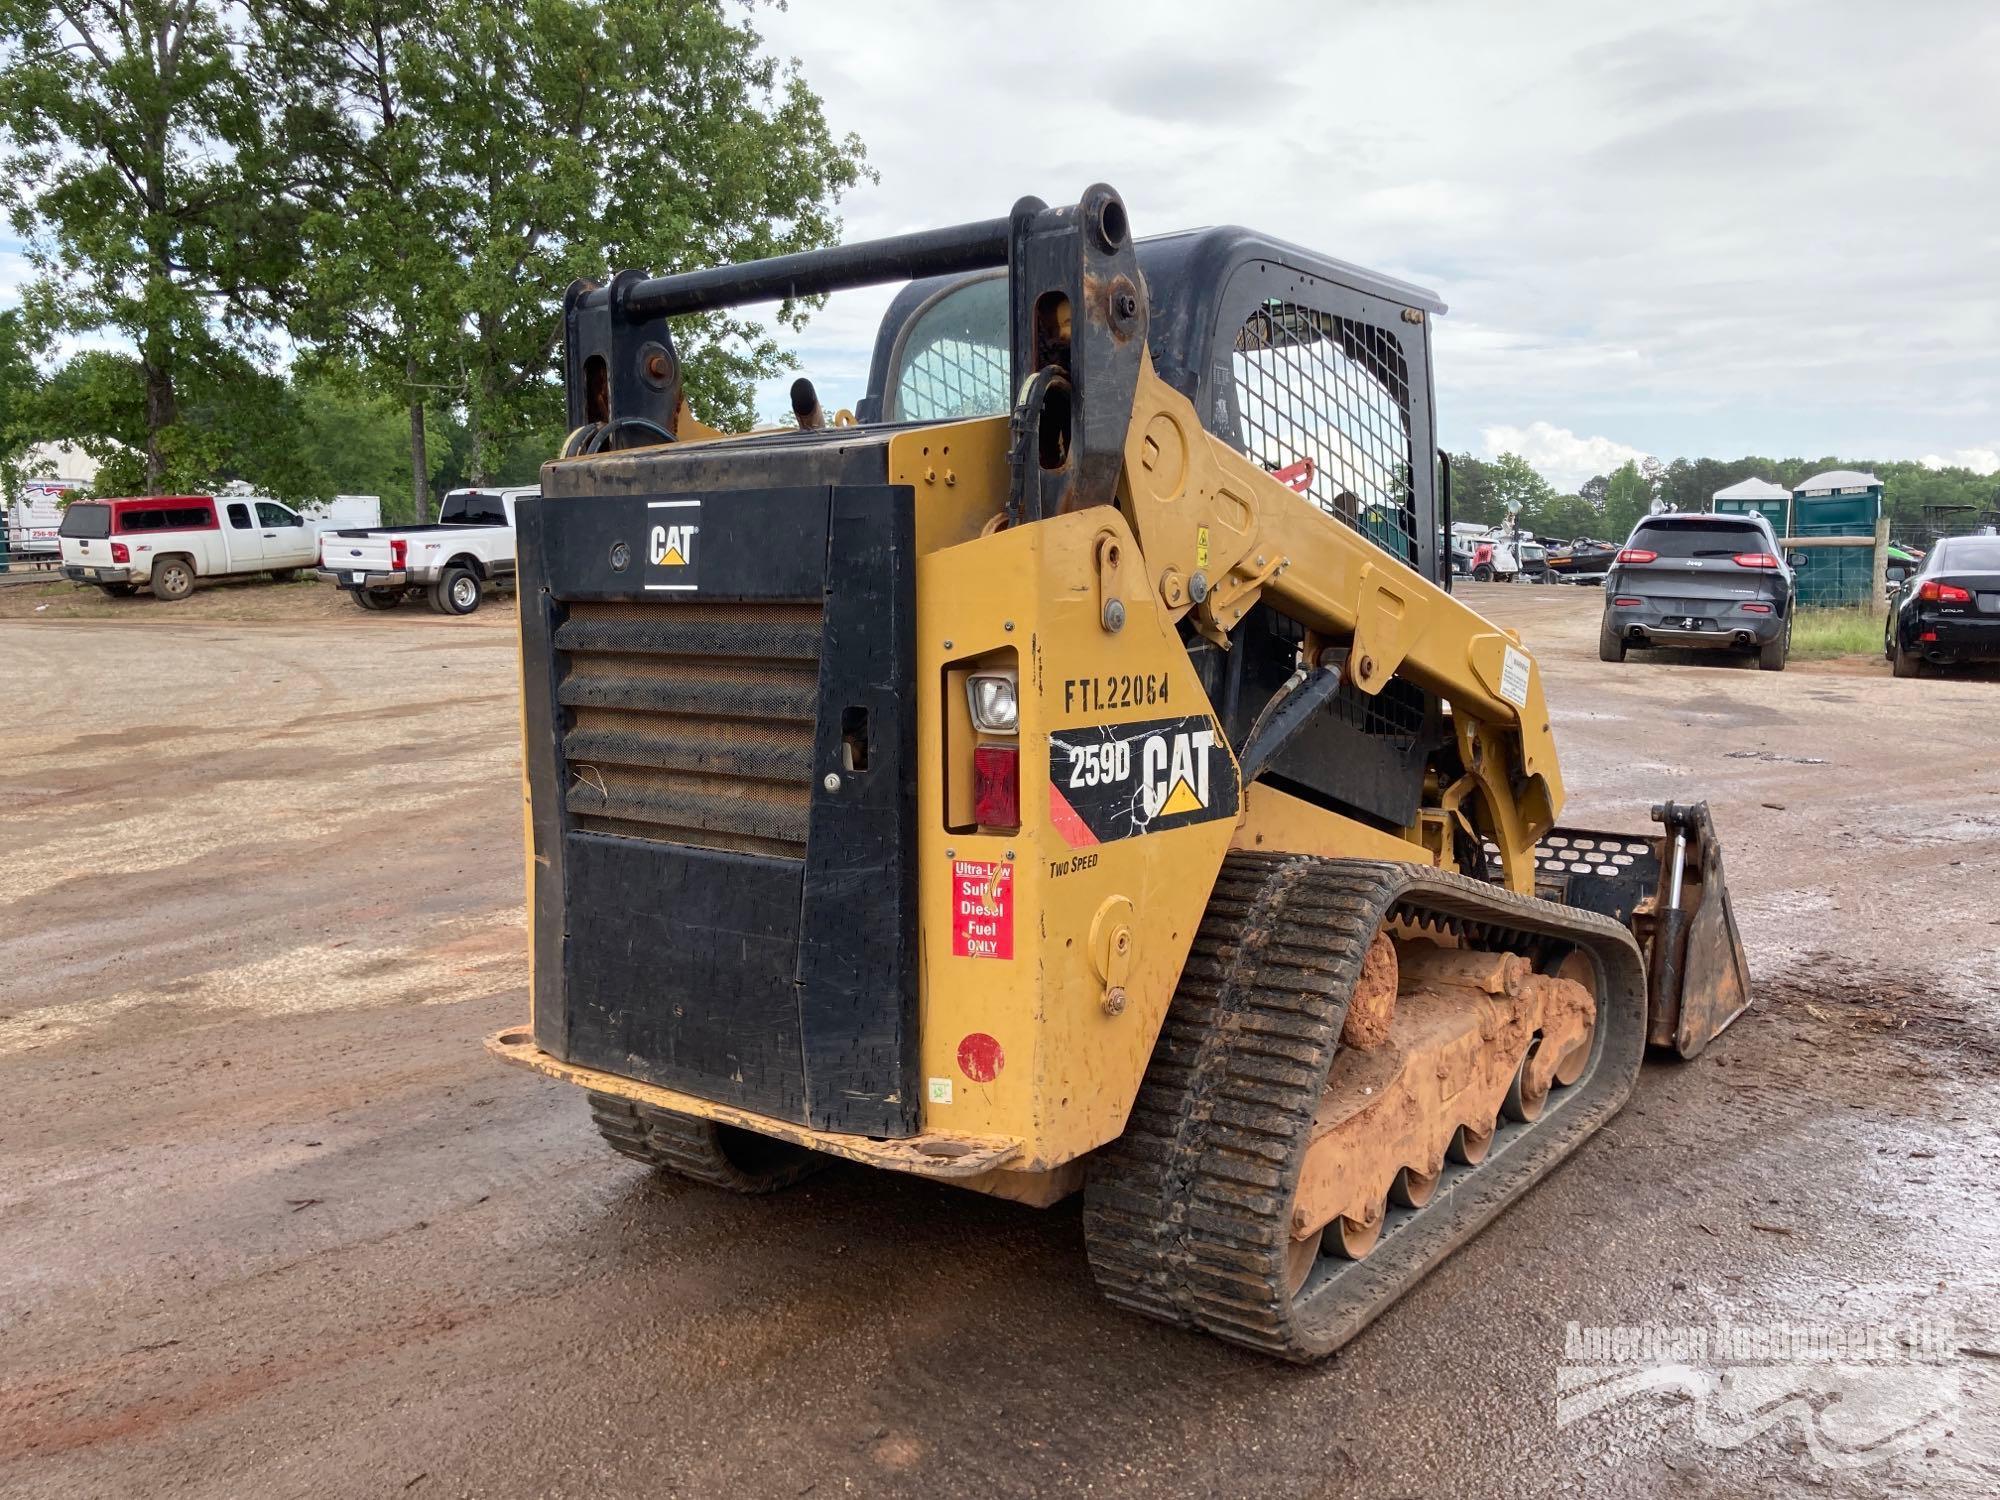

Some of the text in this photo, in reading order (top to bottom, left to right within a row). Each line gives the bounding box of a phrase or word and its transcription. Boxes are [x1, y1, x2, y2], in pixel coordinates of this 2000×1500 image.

[1064, 672, 1169, 714] FTL22064
[1069, 729, 1215, 818] 259D CAT
[968, 920, 997, 936] Fuel
[967, 939, 998, 954] ONLY
